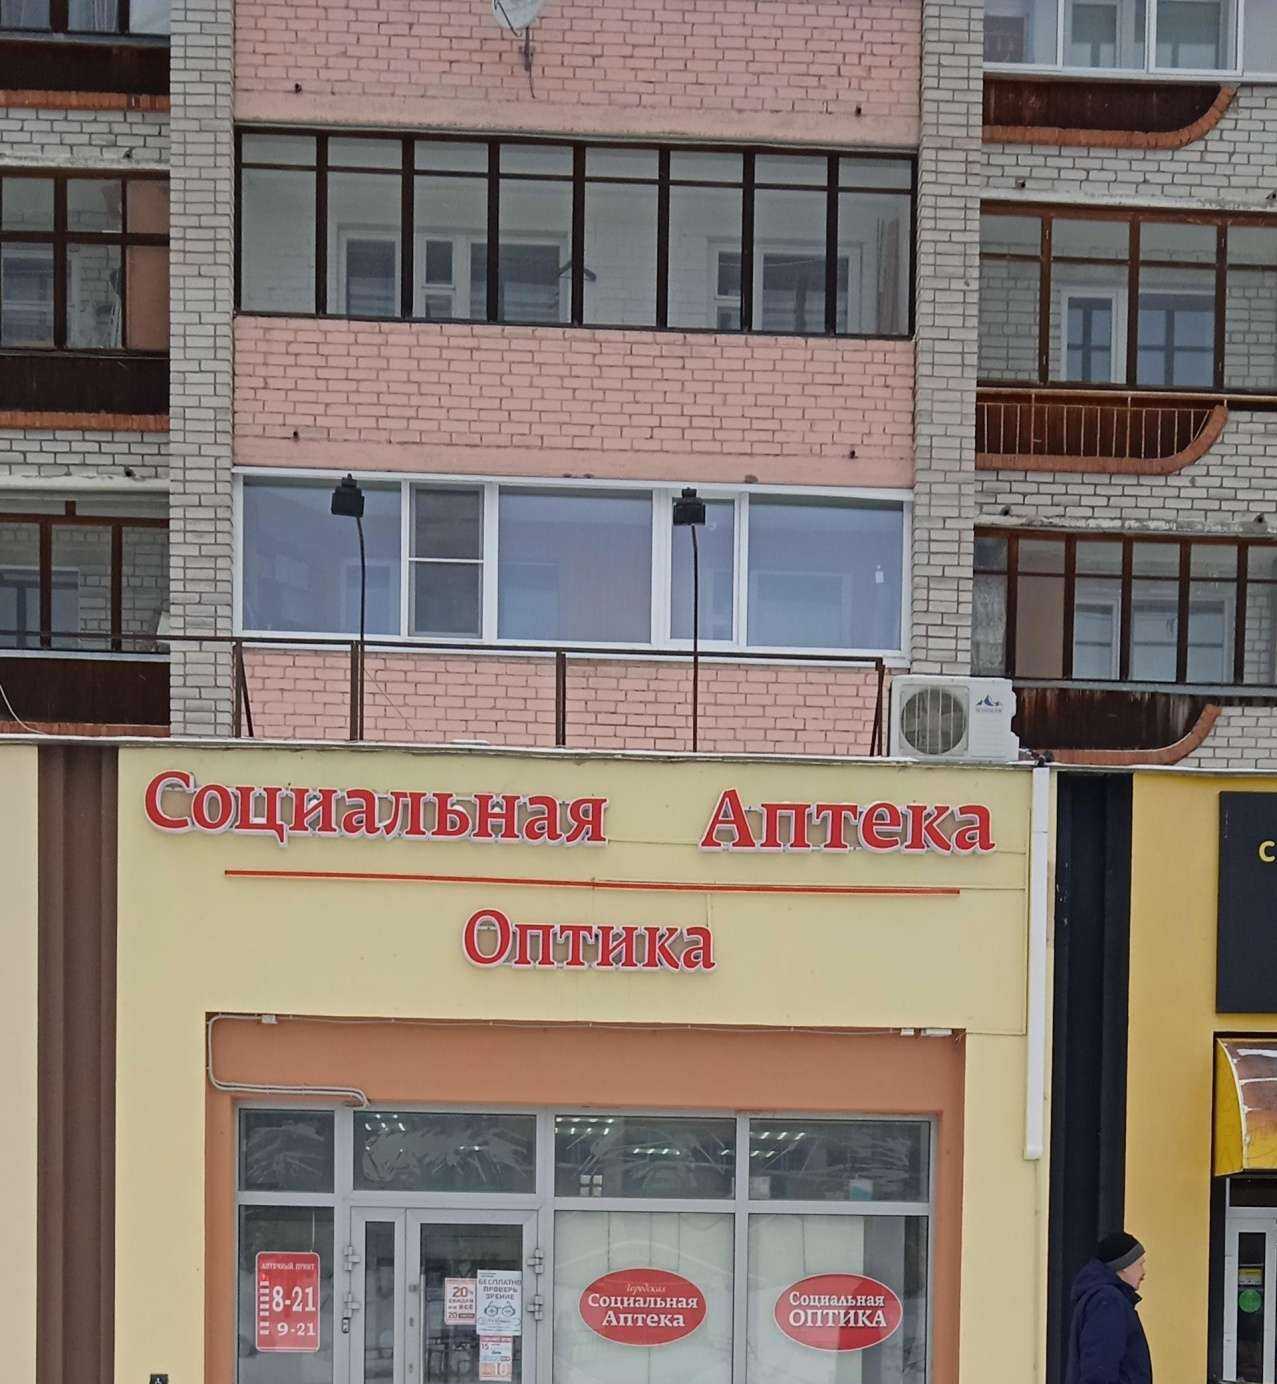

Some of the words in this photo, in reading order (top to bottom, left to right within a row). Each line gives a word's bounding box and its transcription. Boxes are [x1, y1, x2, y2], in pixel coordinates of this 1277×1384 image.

[144, 769, 609, 846] Социальная
[699, 787, 997, 854] Аптека
[463, 908, 718, 971] Оптика
[272, 1286, 316, 1312] 8-21
[588, 1293, 698, 1310] Социальная
[789, 1291, 885, 1307] Социальная
[602, 1310, 685, 1327] Аптека
[788, 1308, 887, 1328] ОПТИКА
[277, 1322, 316, 1336] 9-21
